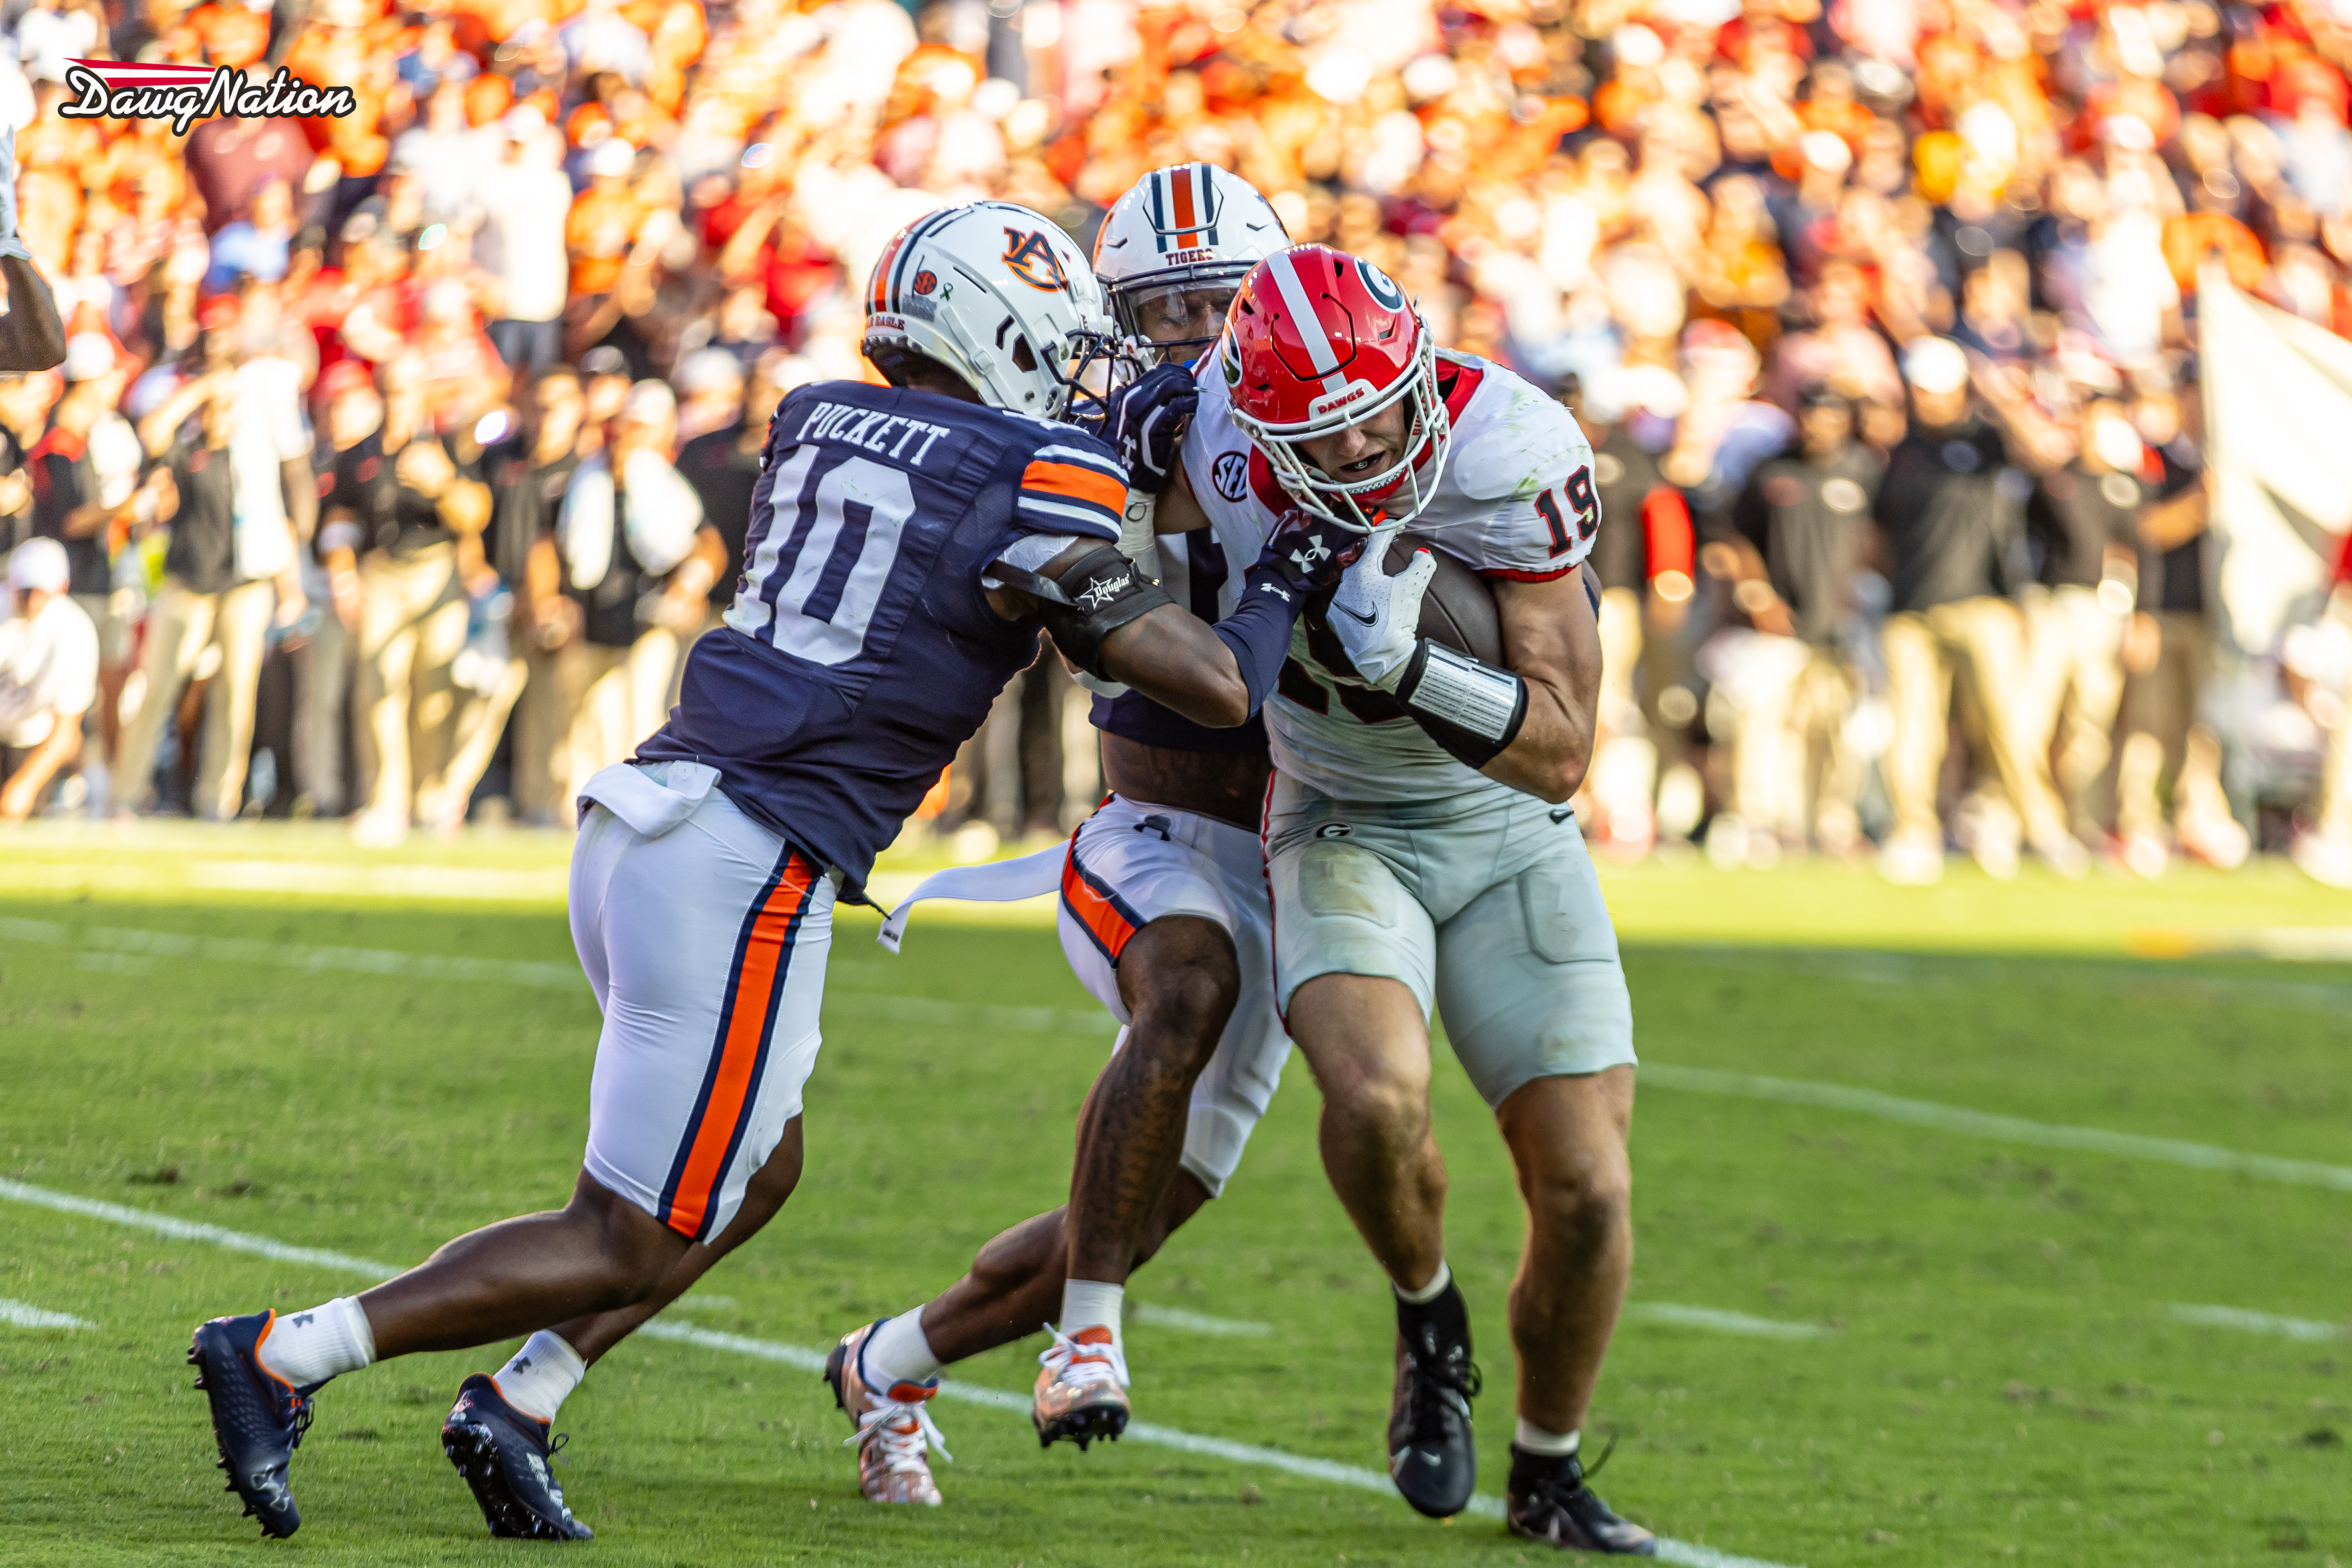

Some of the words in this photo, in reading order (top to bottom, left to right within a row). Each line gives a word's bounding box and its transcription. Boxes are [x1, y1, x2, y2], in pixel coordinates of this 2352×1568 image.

[1317, 387, 1365, 414] DAWGS
[796, 402, 951, 466] PUCKETT
[1534, 465, 1599, 559] 19
[722, 444, 917, 666] 10
[1093, 577, 1130, 597] Douglas
[1324, 825, 1351, 837] G
